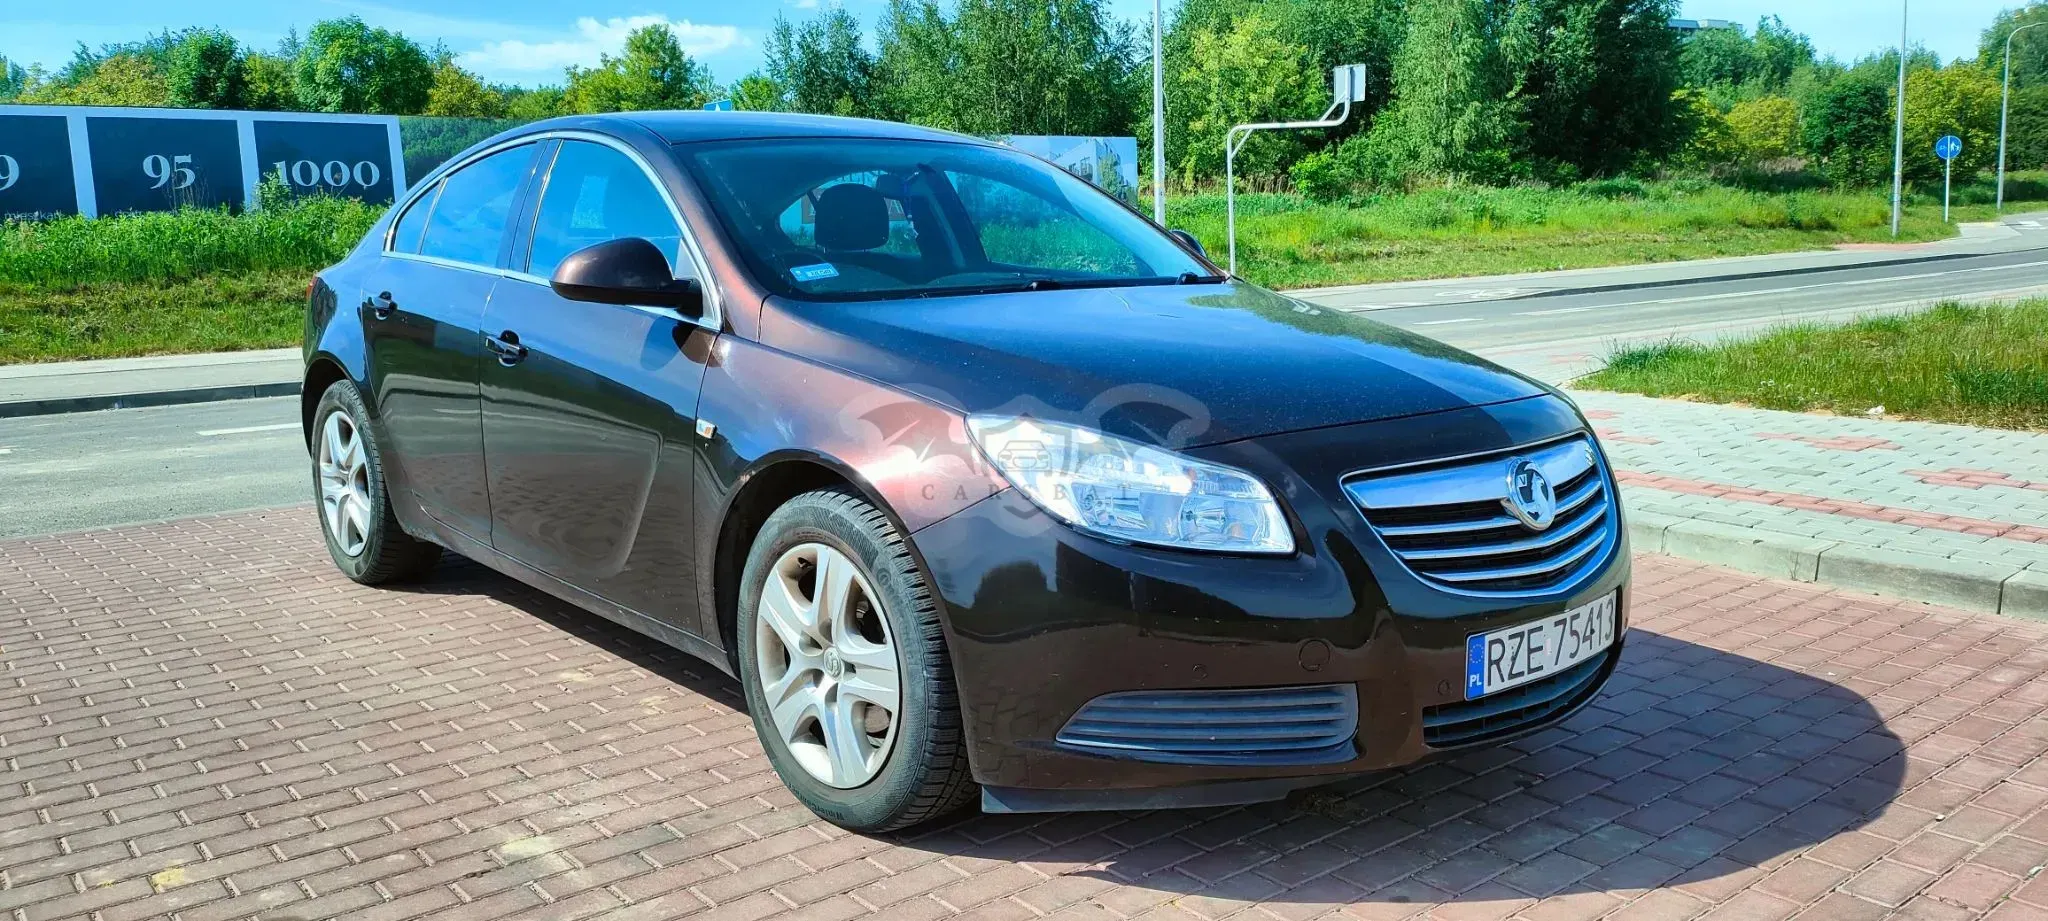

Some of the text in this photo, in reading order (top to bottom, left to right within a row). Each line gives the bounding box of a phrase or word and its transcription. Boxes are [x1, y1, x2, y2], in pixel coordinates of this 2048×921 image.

[142, 153, 197, 190] 95
[273, 160, 381, 188] 1000
[1487, 598, 1614, 686] RZE 75413
[1470, 673, 1482, 687] PL
